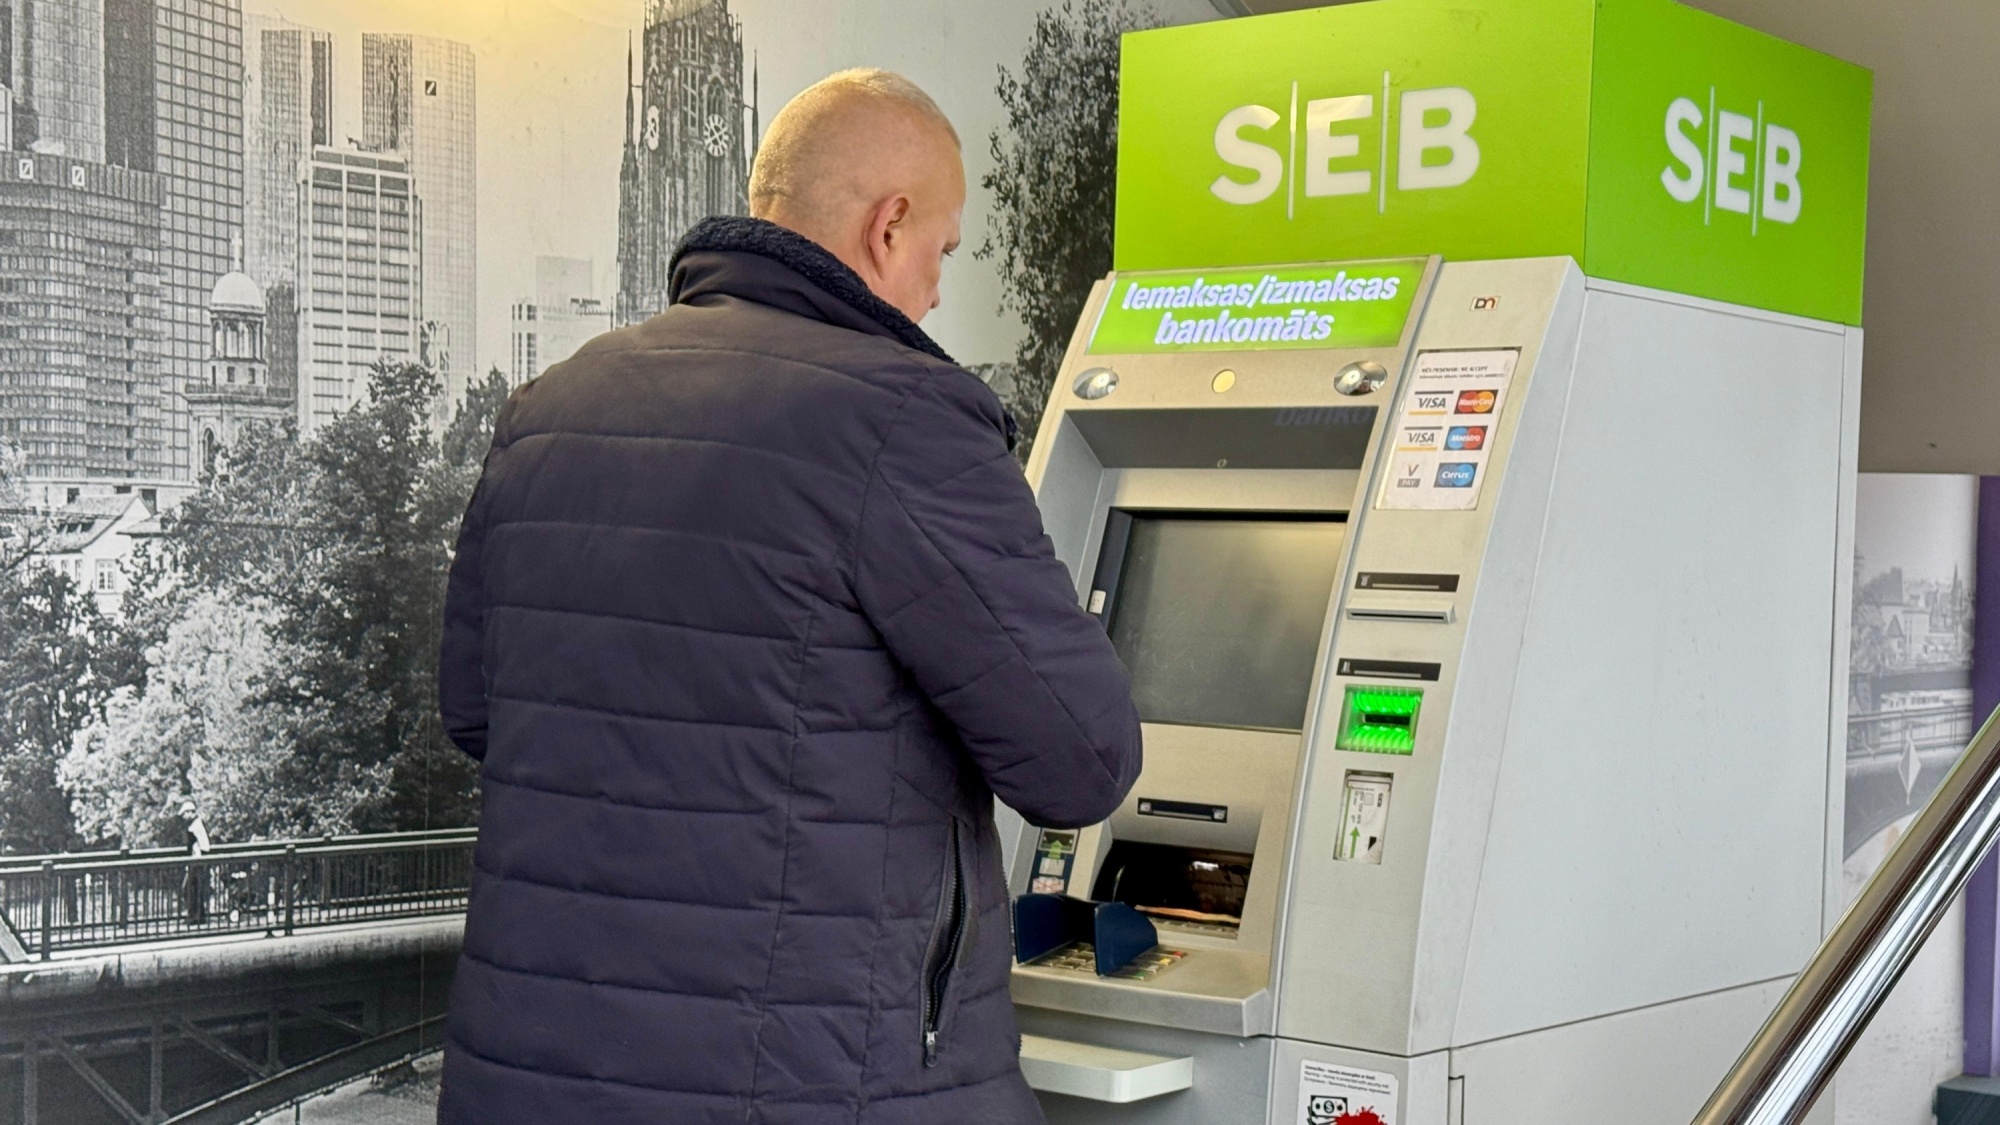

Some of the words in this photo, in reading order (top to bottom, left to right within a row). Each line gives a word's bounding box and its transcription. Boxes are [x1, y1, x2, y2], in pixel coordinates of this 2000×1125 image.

[1209, 86, 1481, 205] SEB
[1660, 96, 1802, 225] SEB
[1122, 271, 1400, 310] Iemaksas/izmaksas
[1154, 308, 1334, 345] bankomāts
[1417, 397, 1446, 408] VISA
[1408, 432, 1435, 443] VISA
[1442, 471, 1470, 479] Cirrus
